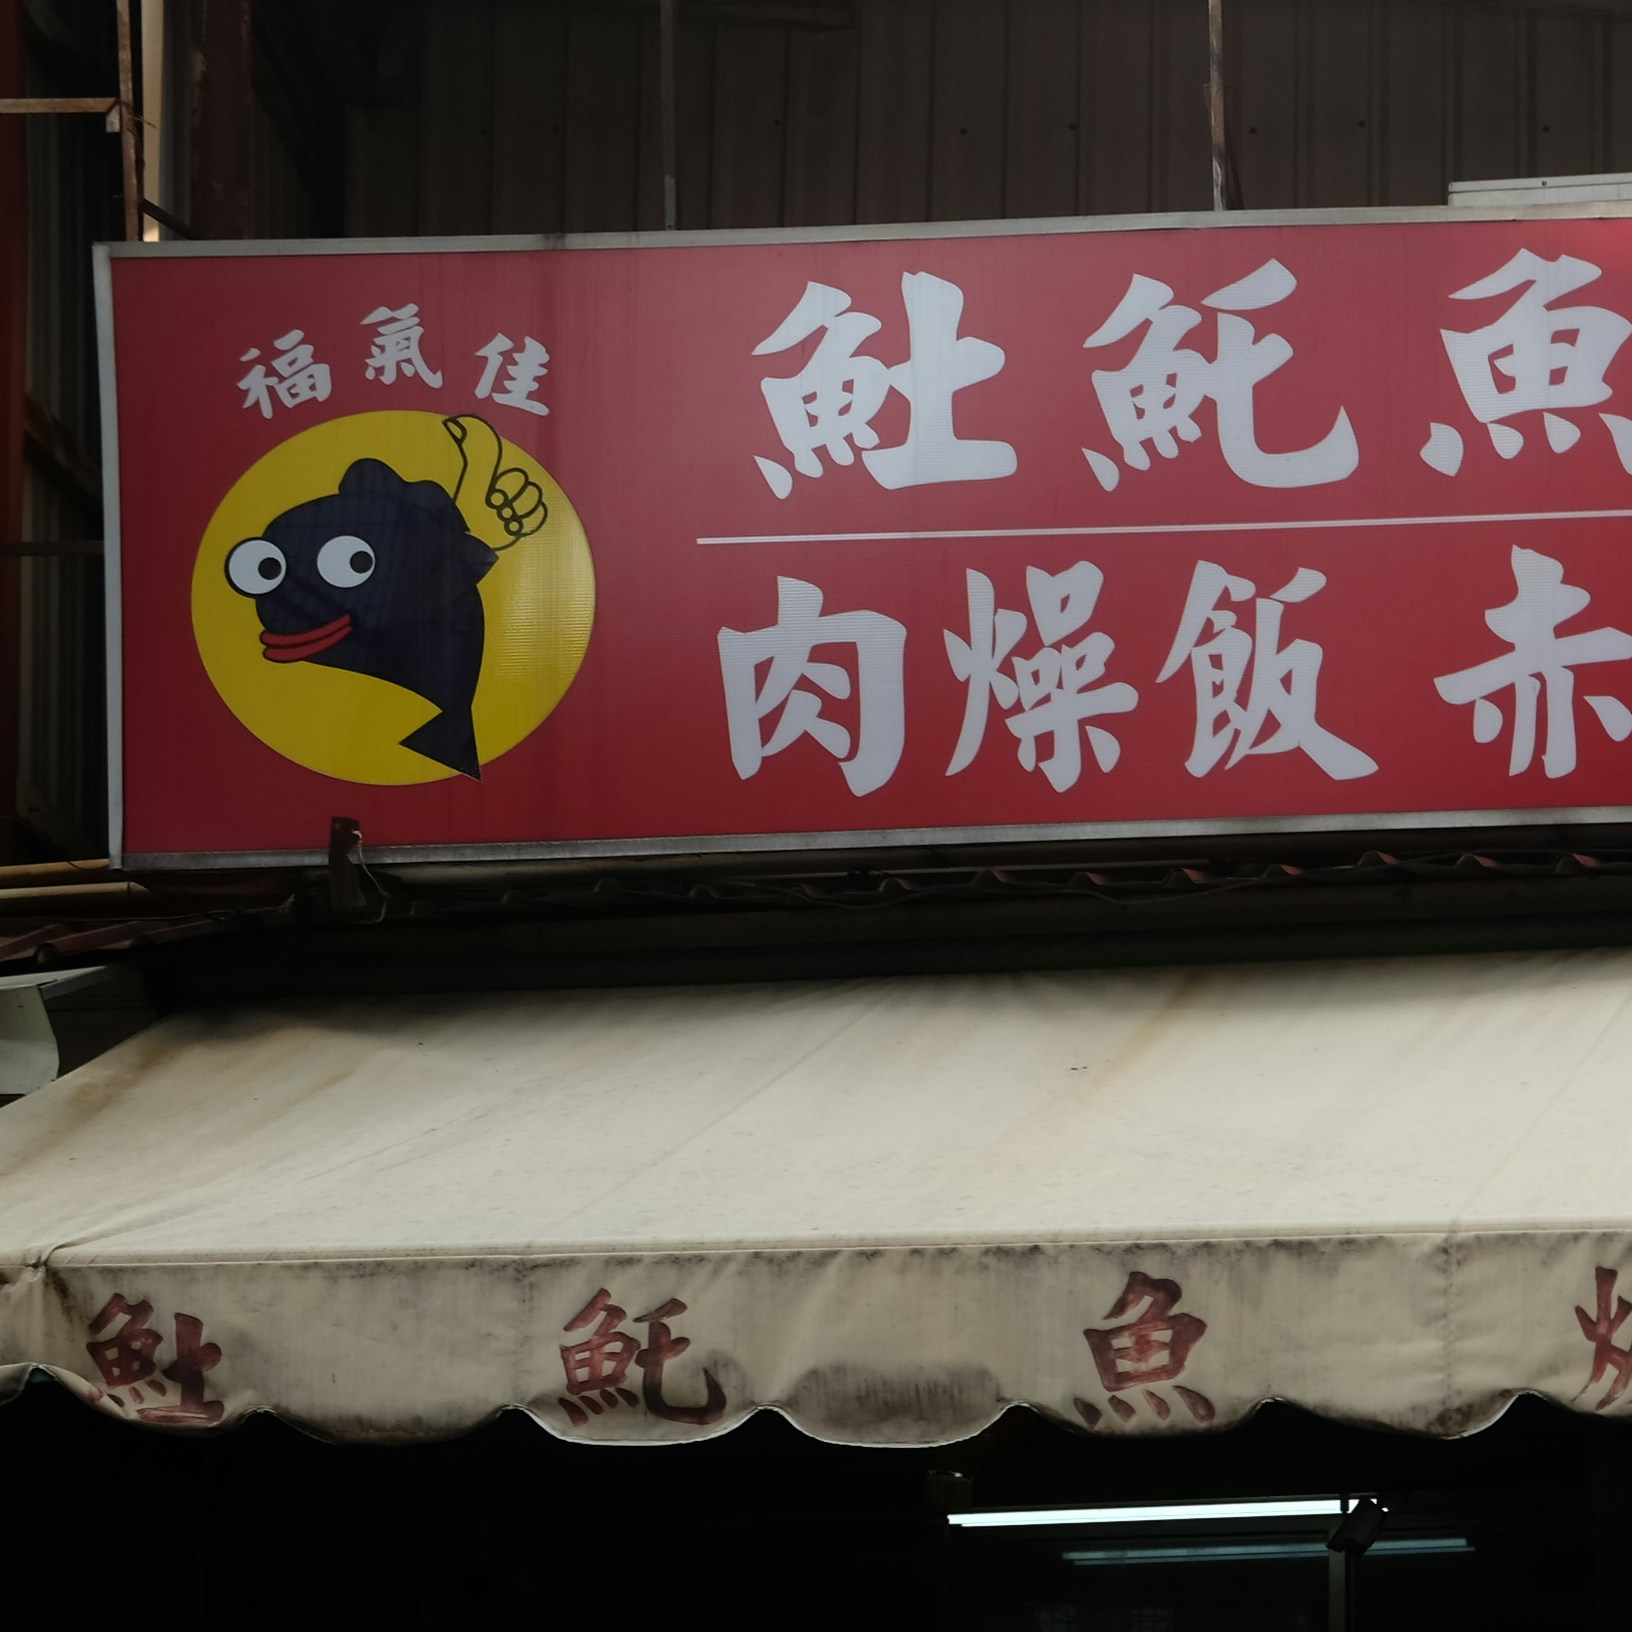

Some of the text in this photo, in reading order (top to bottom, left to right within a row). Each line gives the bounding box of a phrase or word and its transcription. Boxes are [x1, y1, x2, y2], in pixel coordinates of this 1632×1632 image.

[238, 303, 550, 419] 福氣佳
[717, 560, 1379, 797] 肉燥飯
